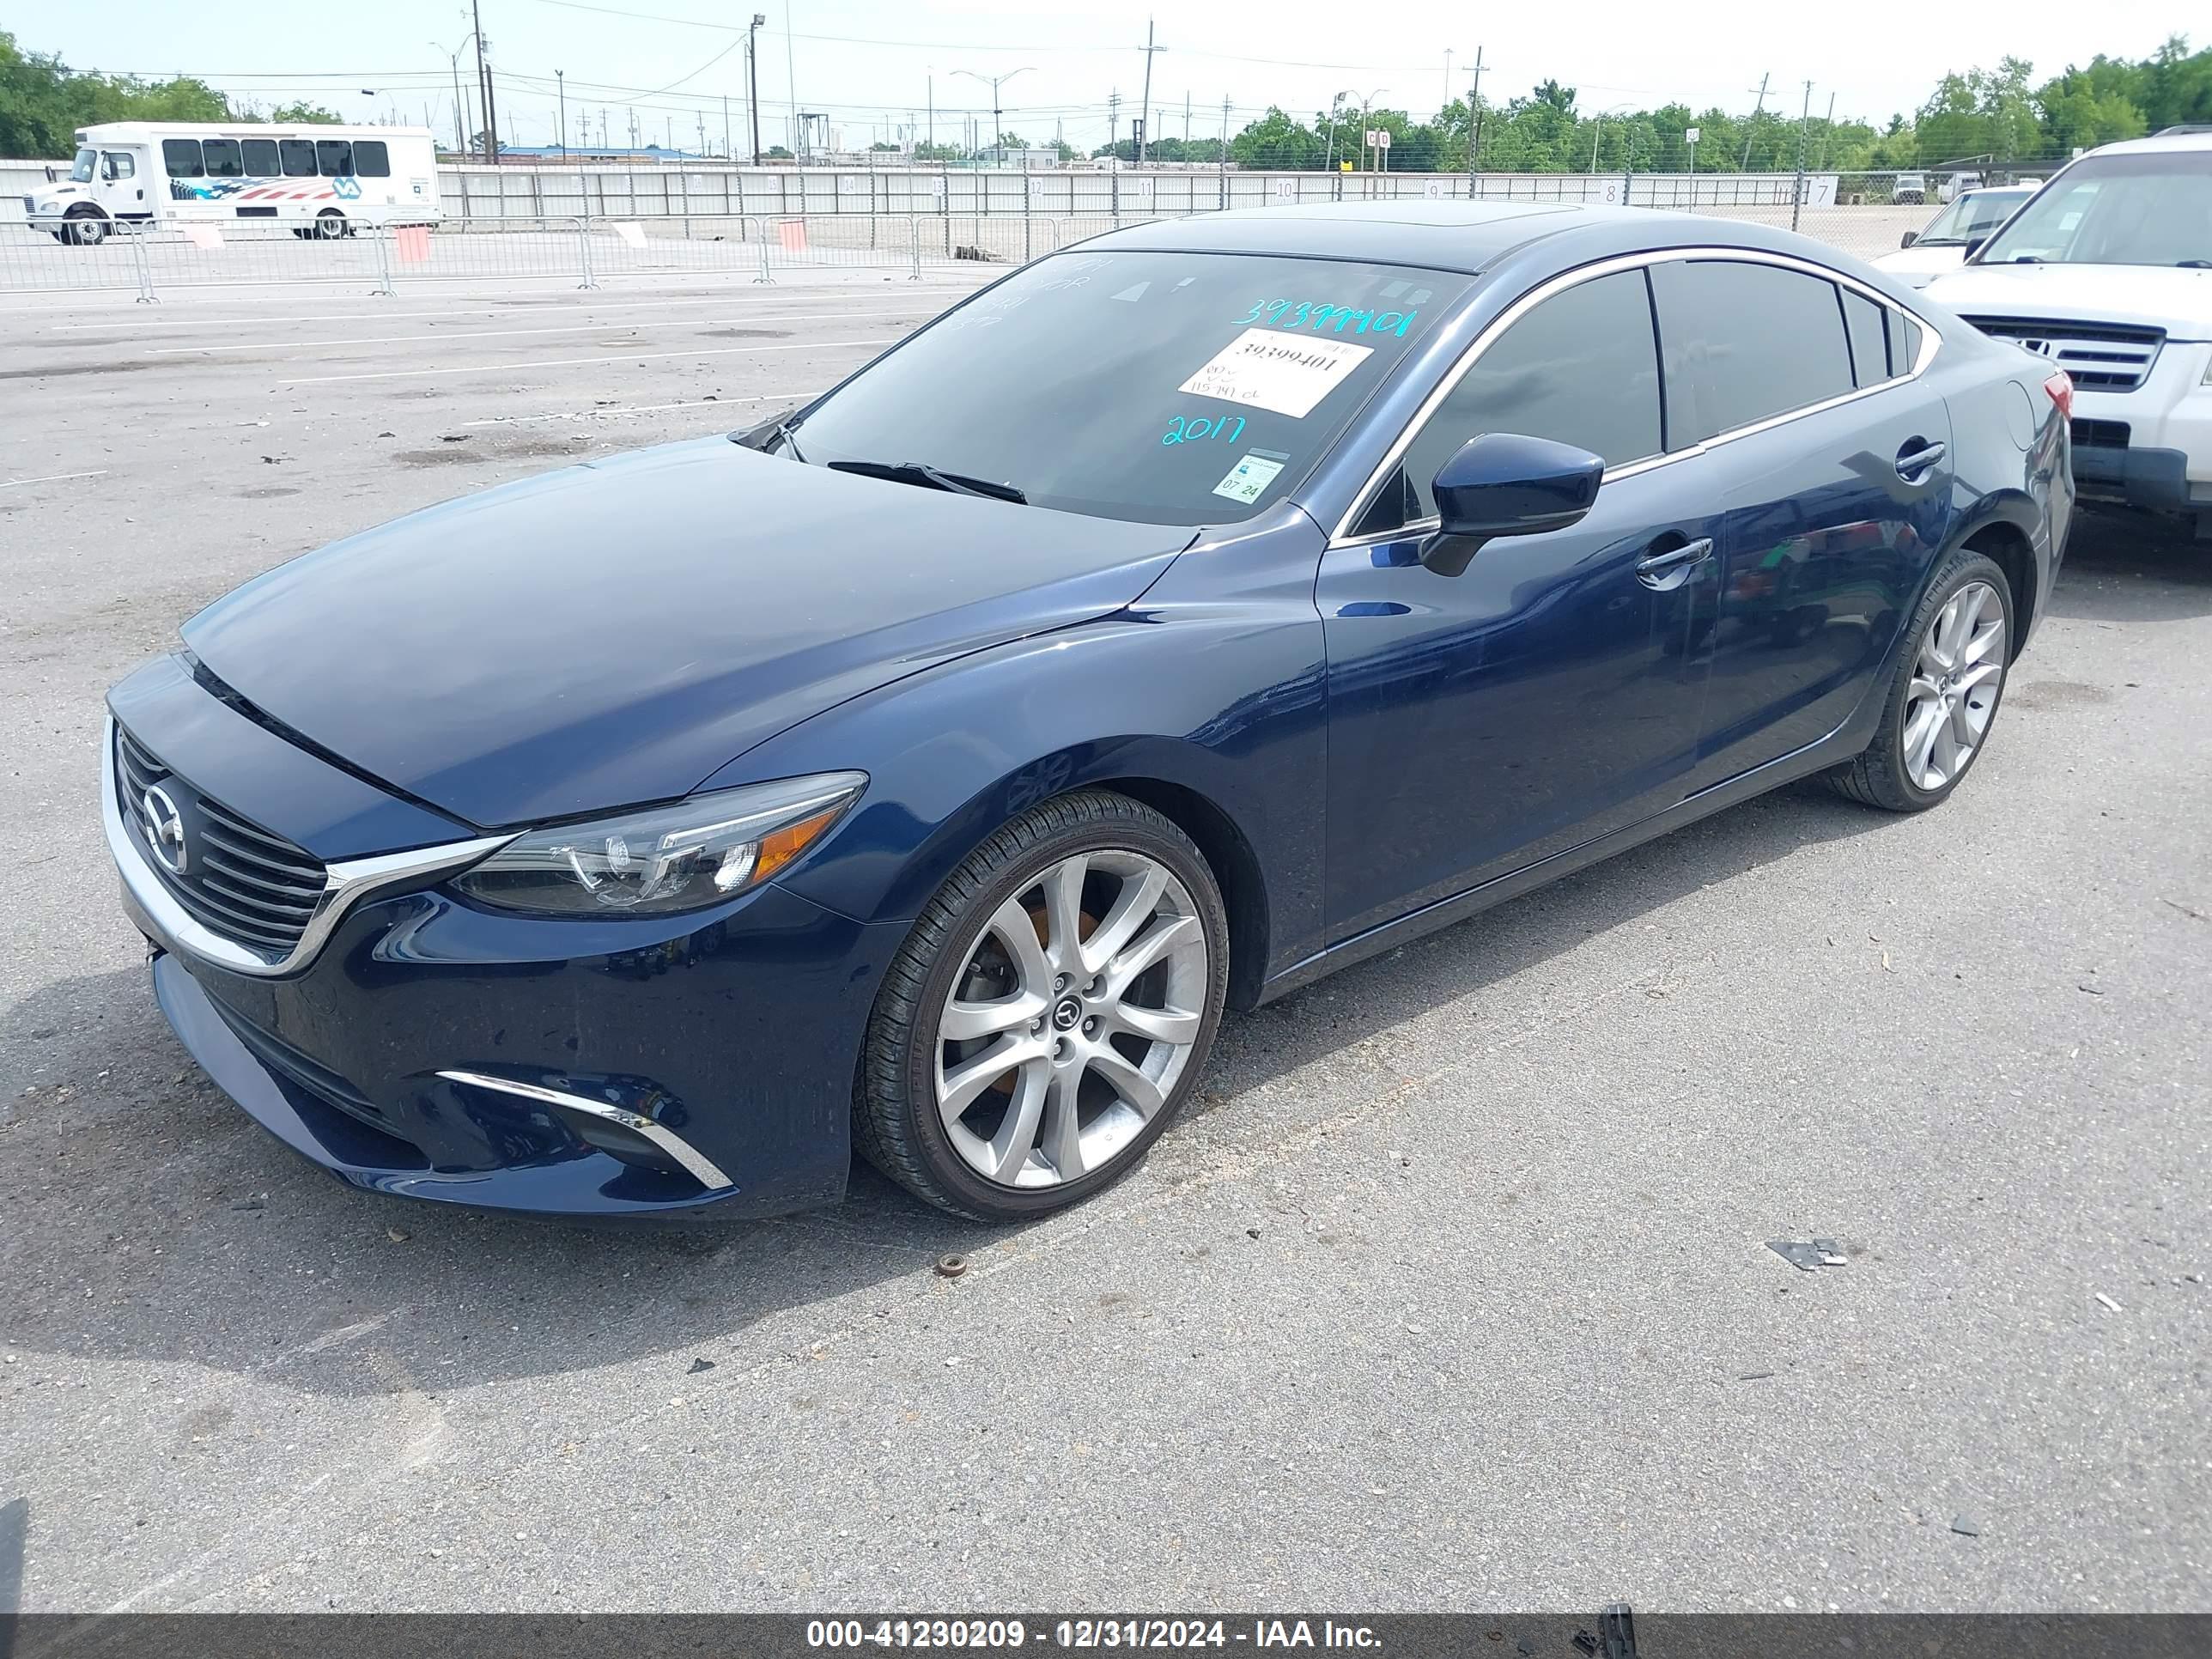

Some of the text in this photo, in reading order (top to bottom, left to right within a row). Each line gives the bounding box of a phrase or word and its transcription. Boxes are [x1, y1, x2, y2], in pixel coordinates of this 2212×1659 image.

[1370, 134, 1375, 143] C
[1382, 135, 1388, 144] D
[933, 180, 942, 192] 13
[1031, 181, 1042, 194] 12
[1140, 182, 1152, 196] 11
[1277, 183, 1291, 198] 10
[1430, 185, 1437, 199] 9
[1606, 185, 1616, 202] 8
[1818, 185, 1828, 203] 7
[1231, 299, 1417, 337] 39399401
[1236, 343, 1338, 371] 39399401
[1162, 416, 1246, 445] 2017
[1223, 479, 1259, 496] 07 24
[913, 1029, 927, 1092] PLUS
